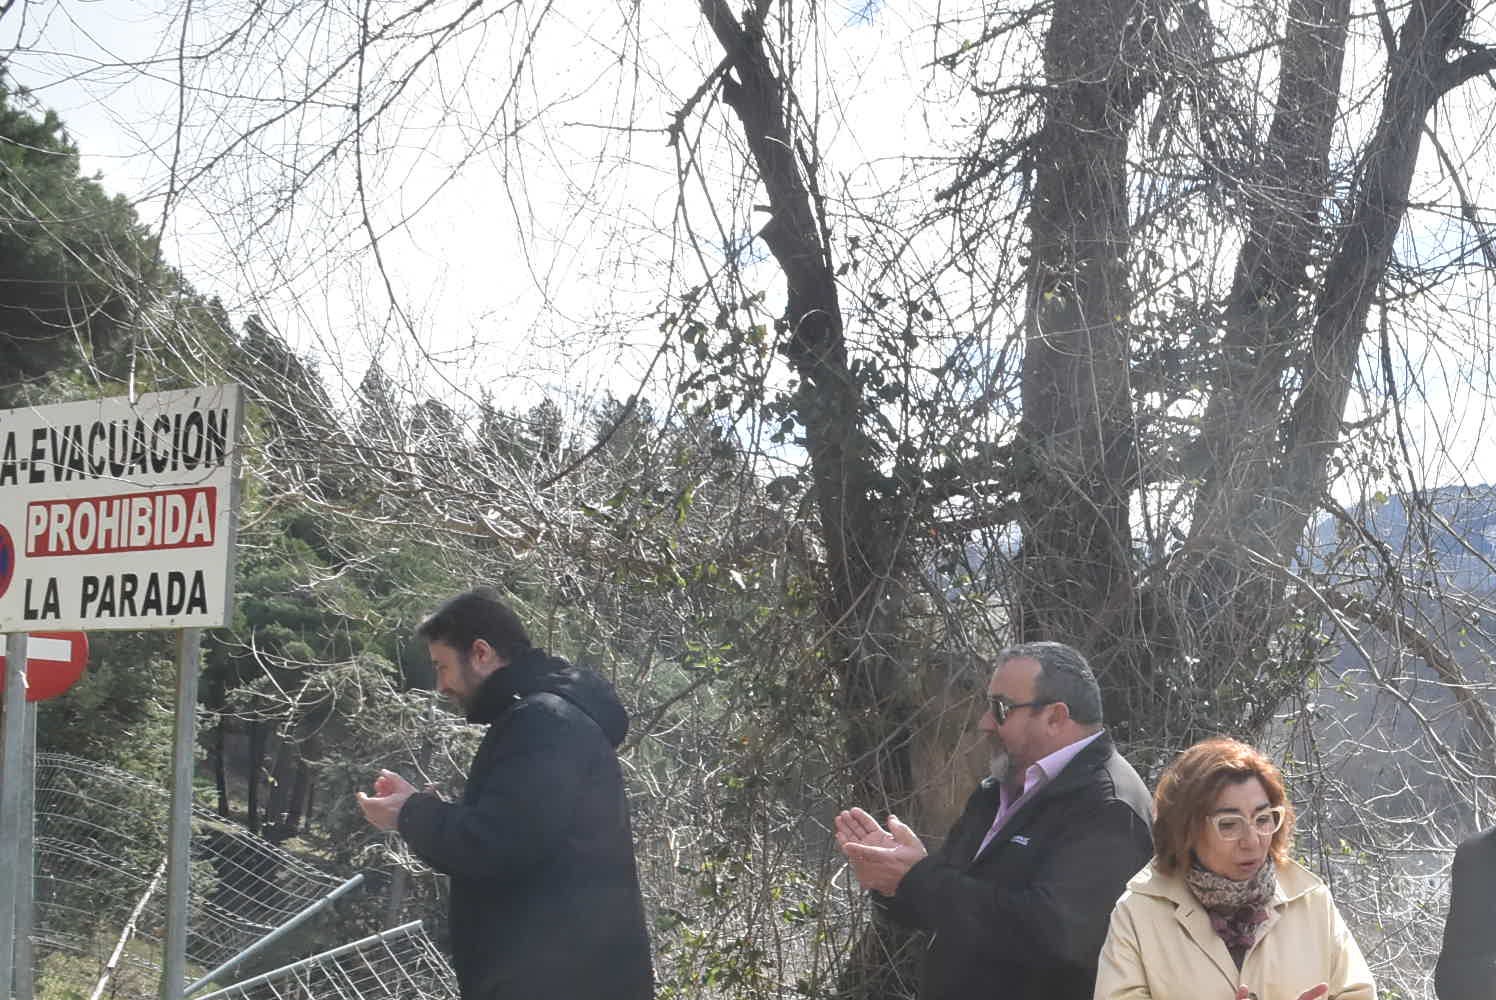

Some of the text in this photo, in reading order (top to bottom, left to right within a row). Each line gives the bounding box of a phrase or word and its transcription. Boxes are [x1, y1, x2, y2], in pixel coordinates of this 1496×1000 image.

[28, 491, 212, 553] PROHIBIDA
[24, 570, 208, 621] LA PARADA
